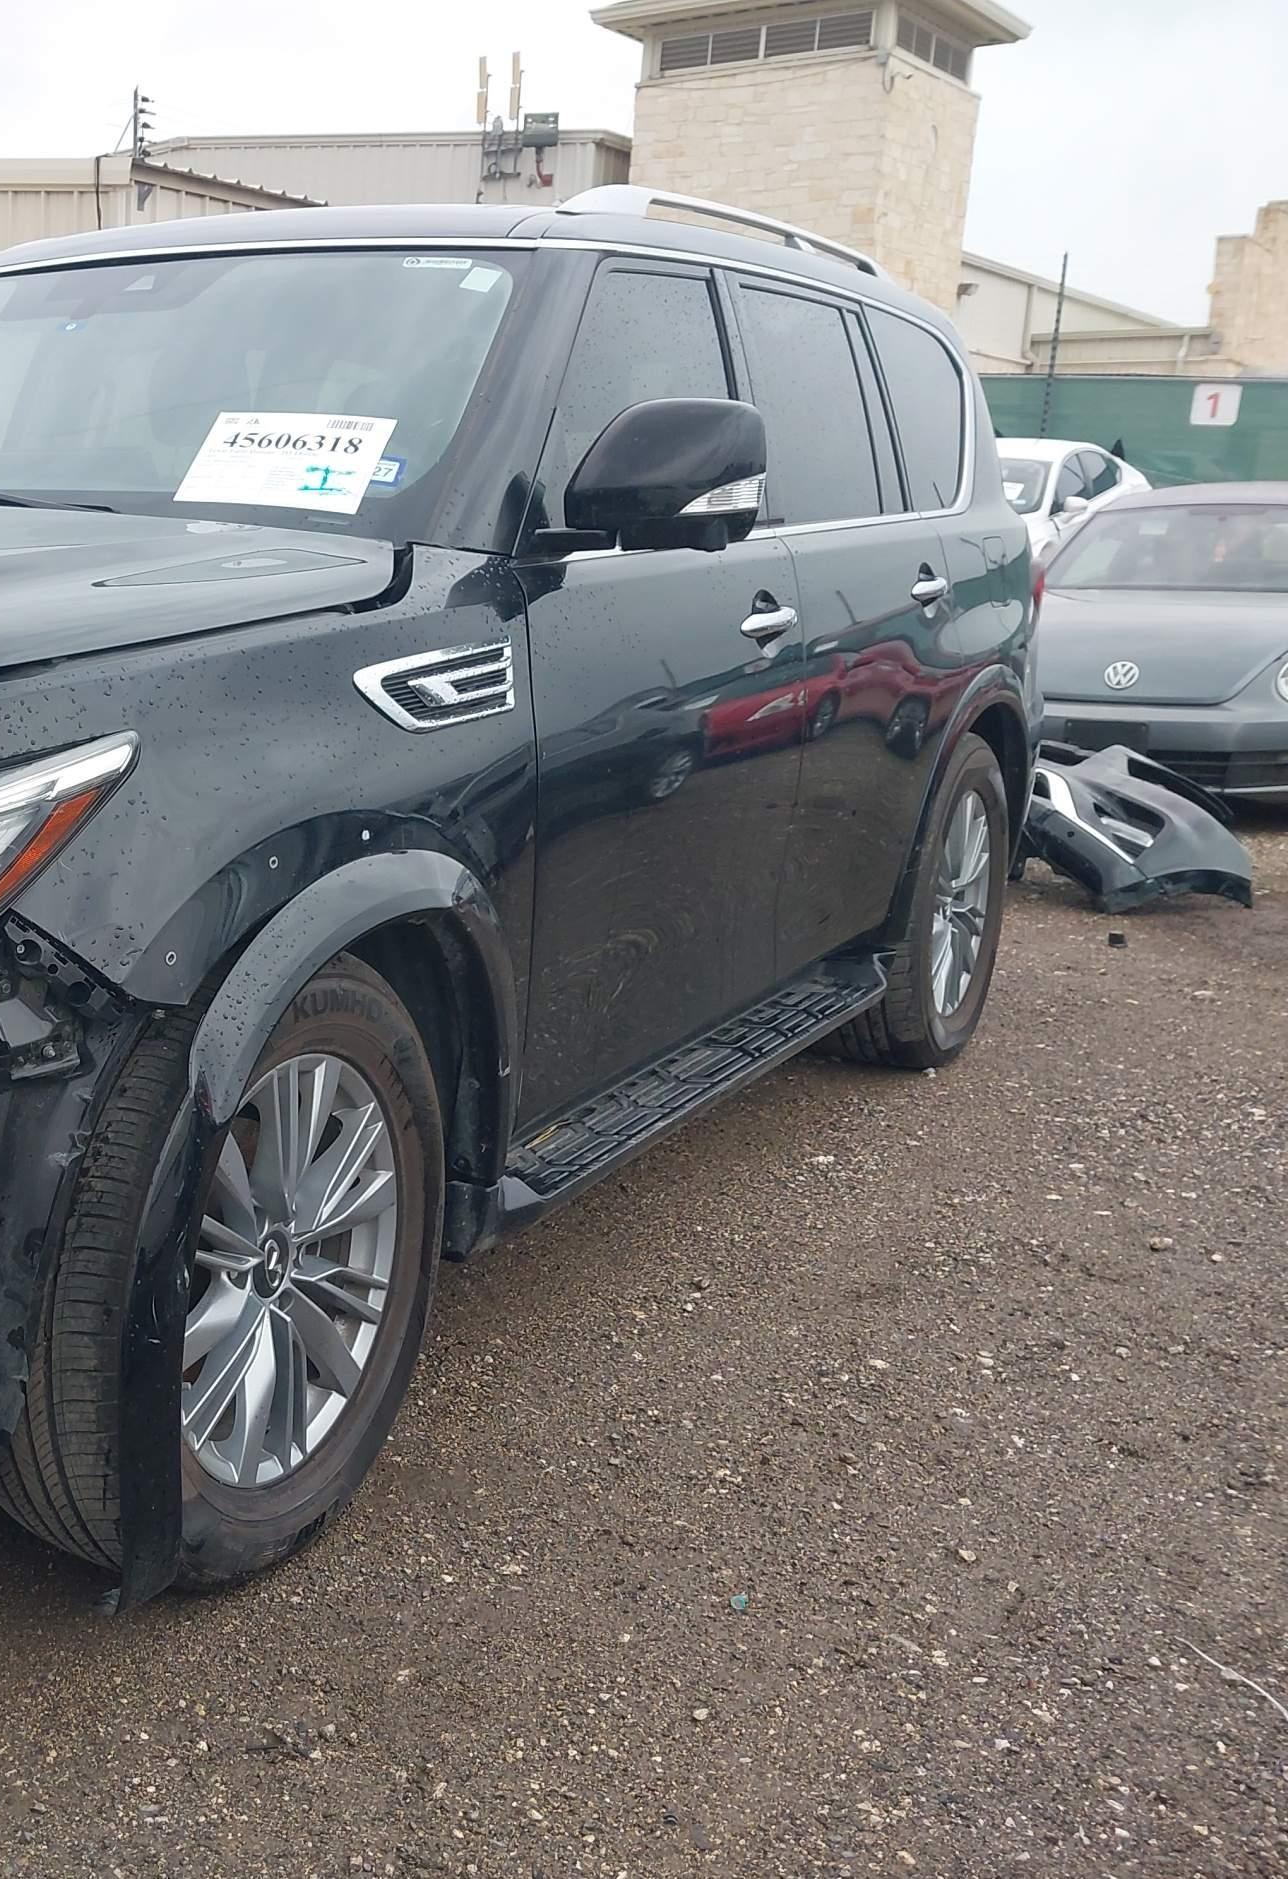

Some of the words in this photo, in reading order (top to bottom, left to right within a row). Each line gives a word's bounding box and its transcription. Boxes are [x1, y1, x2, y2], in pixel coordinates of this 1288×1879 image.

[1207, 391, 1221, 418] 1
[223, 431, 363, 455] 45606318
[372, 466, 394, 477] 27
[291, 988, 384, 1025] KUMHO
